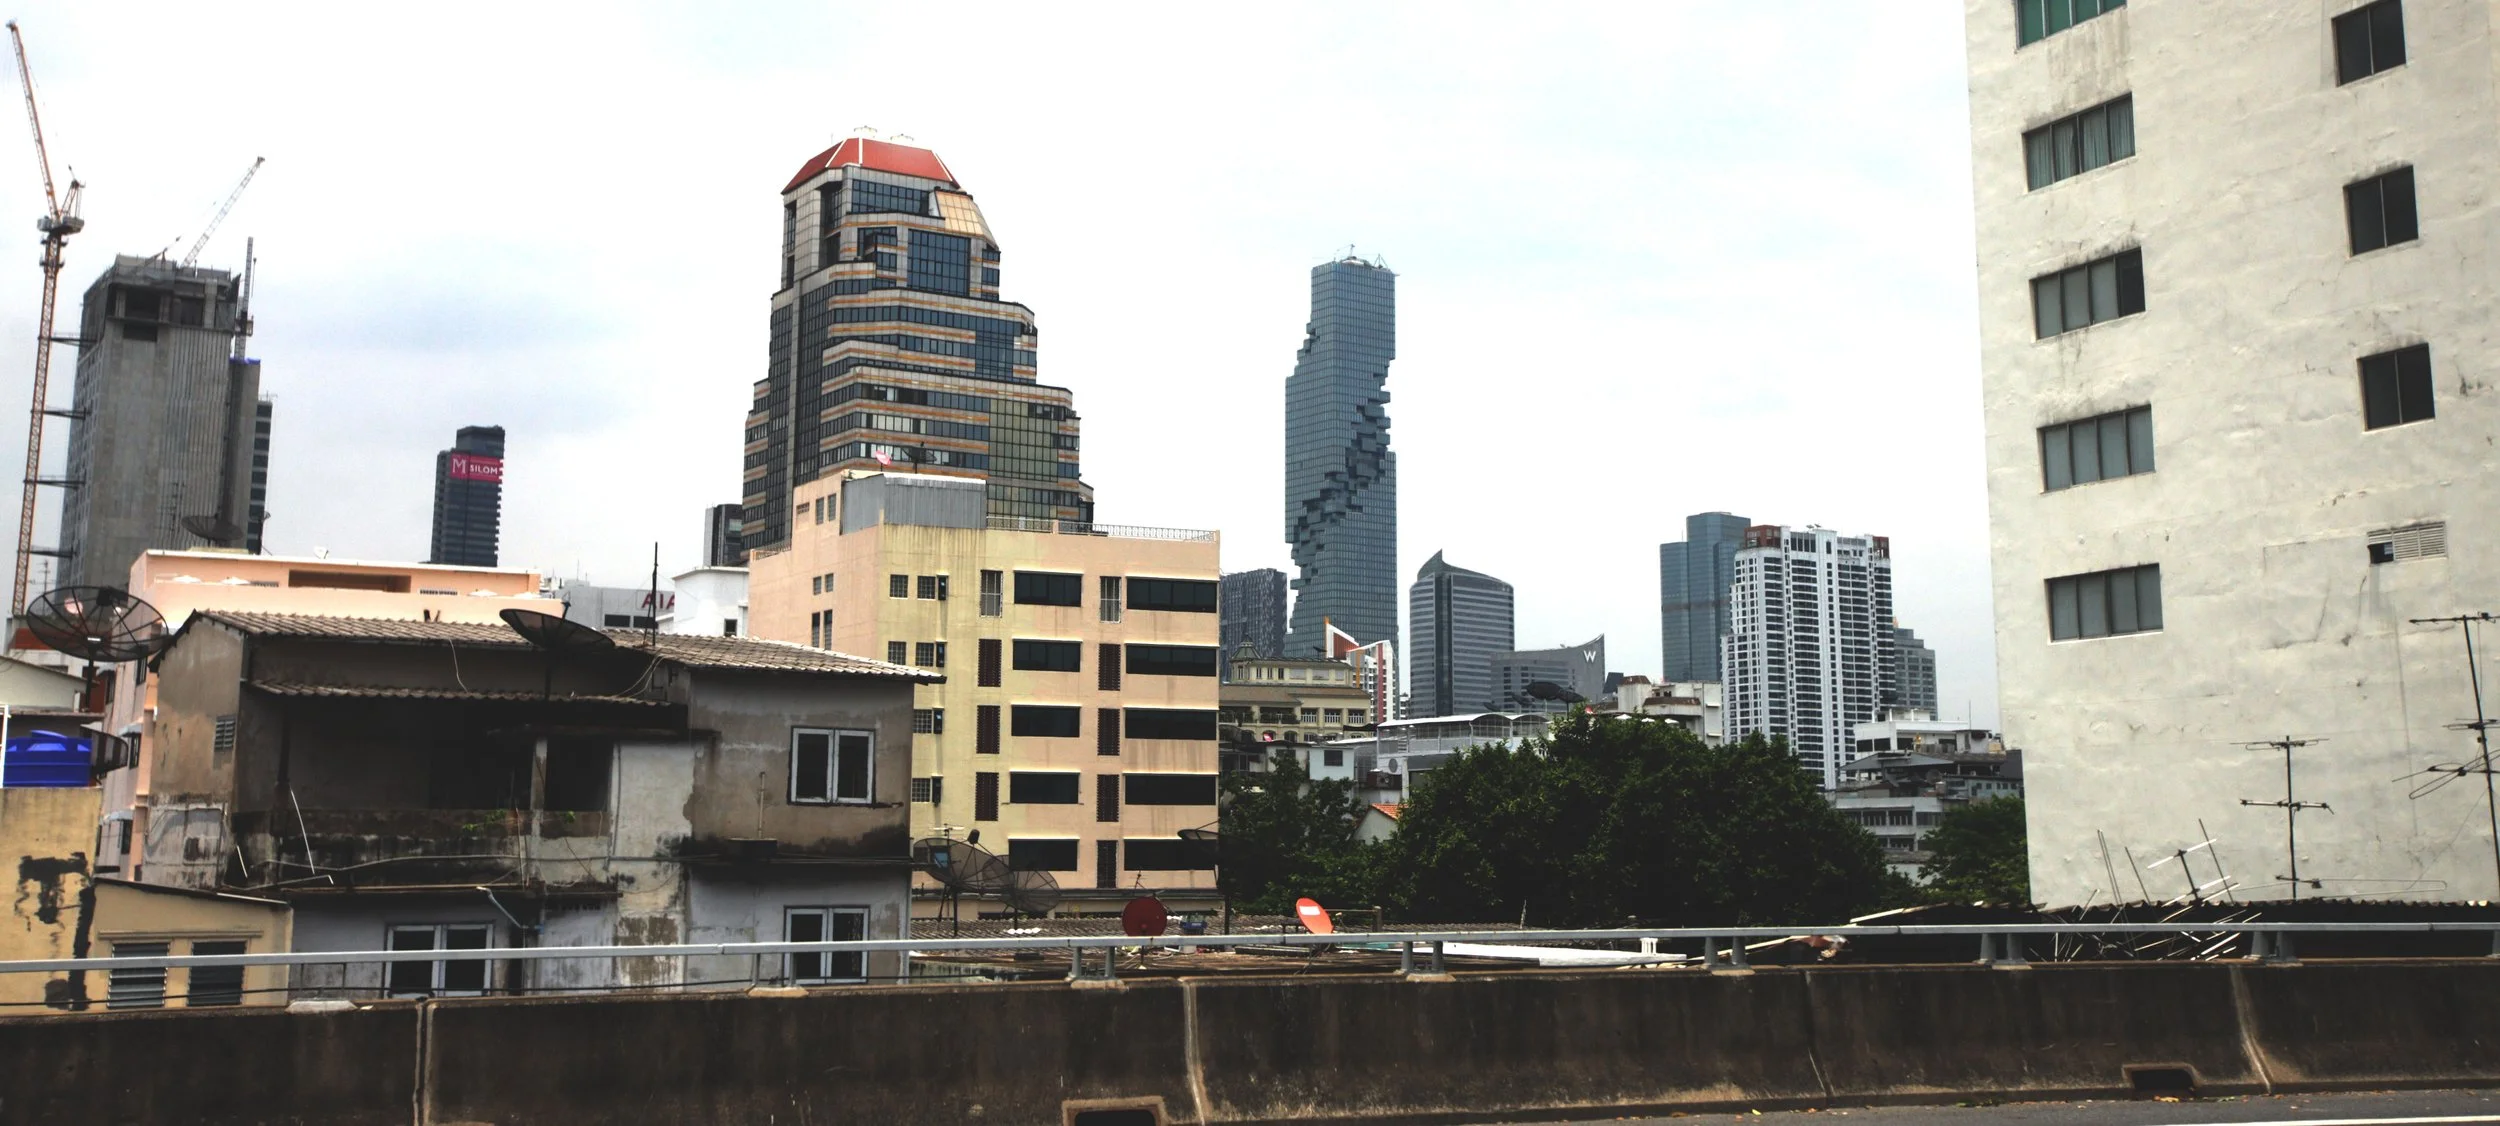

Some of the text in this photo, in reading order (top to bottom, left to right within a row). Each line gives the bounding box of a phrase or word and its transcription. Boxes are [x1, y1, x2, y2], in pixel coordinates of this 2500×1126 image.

[452, 458, 498, 475] M SILOM
[1583, 650, 1596, 663] W
